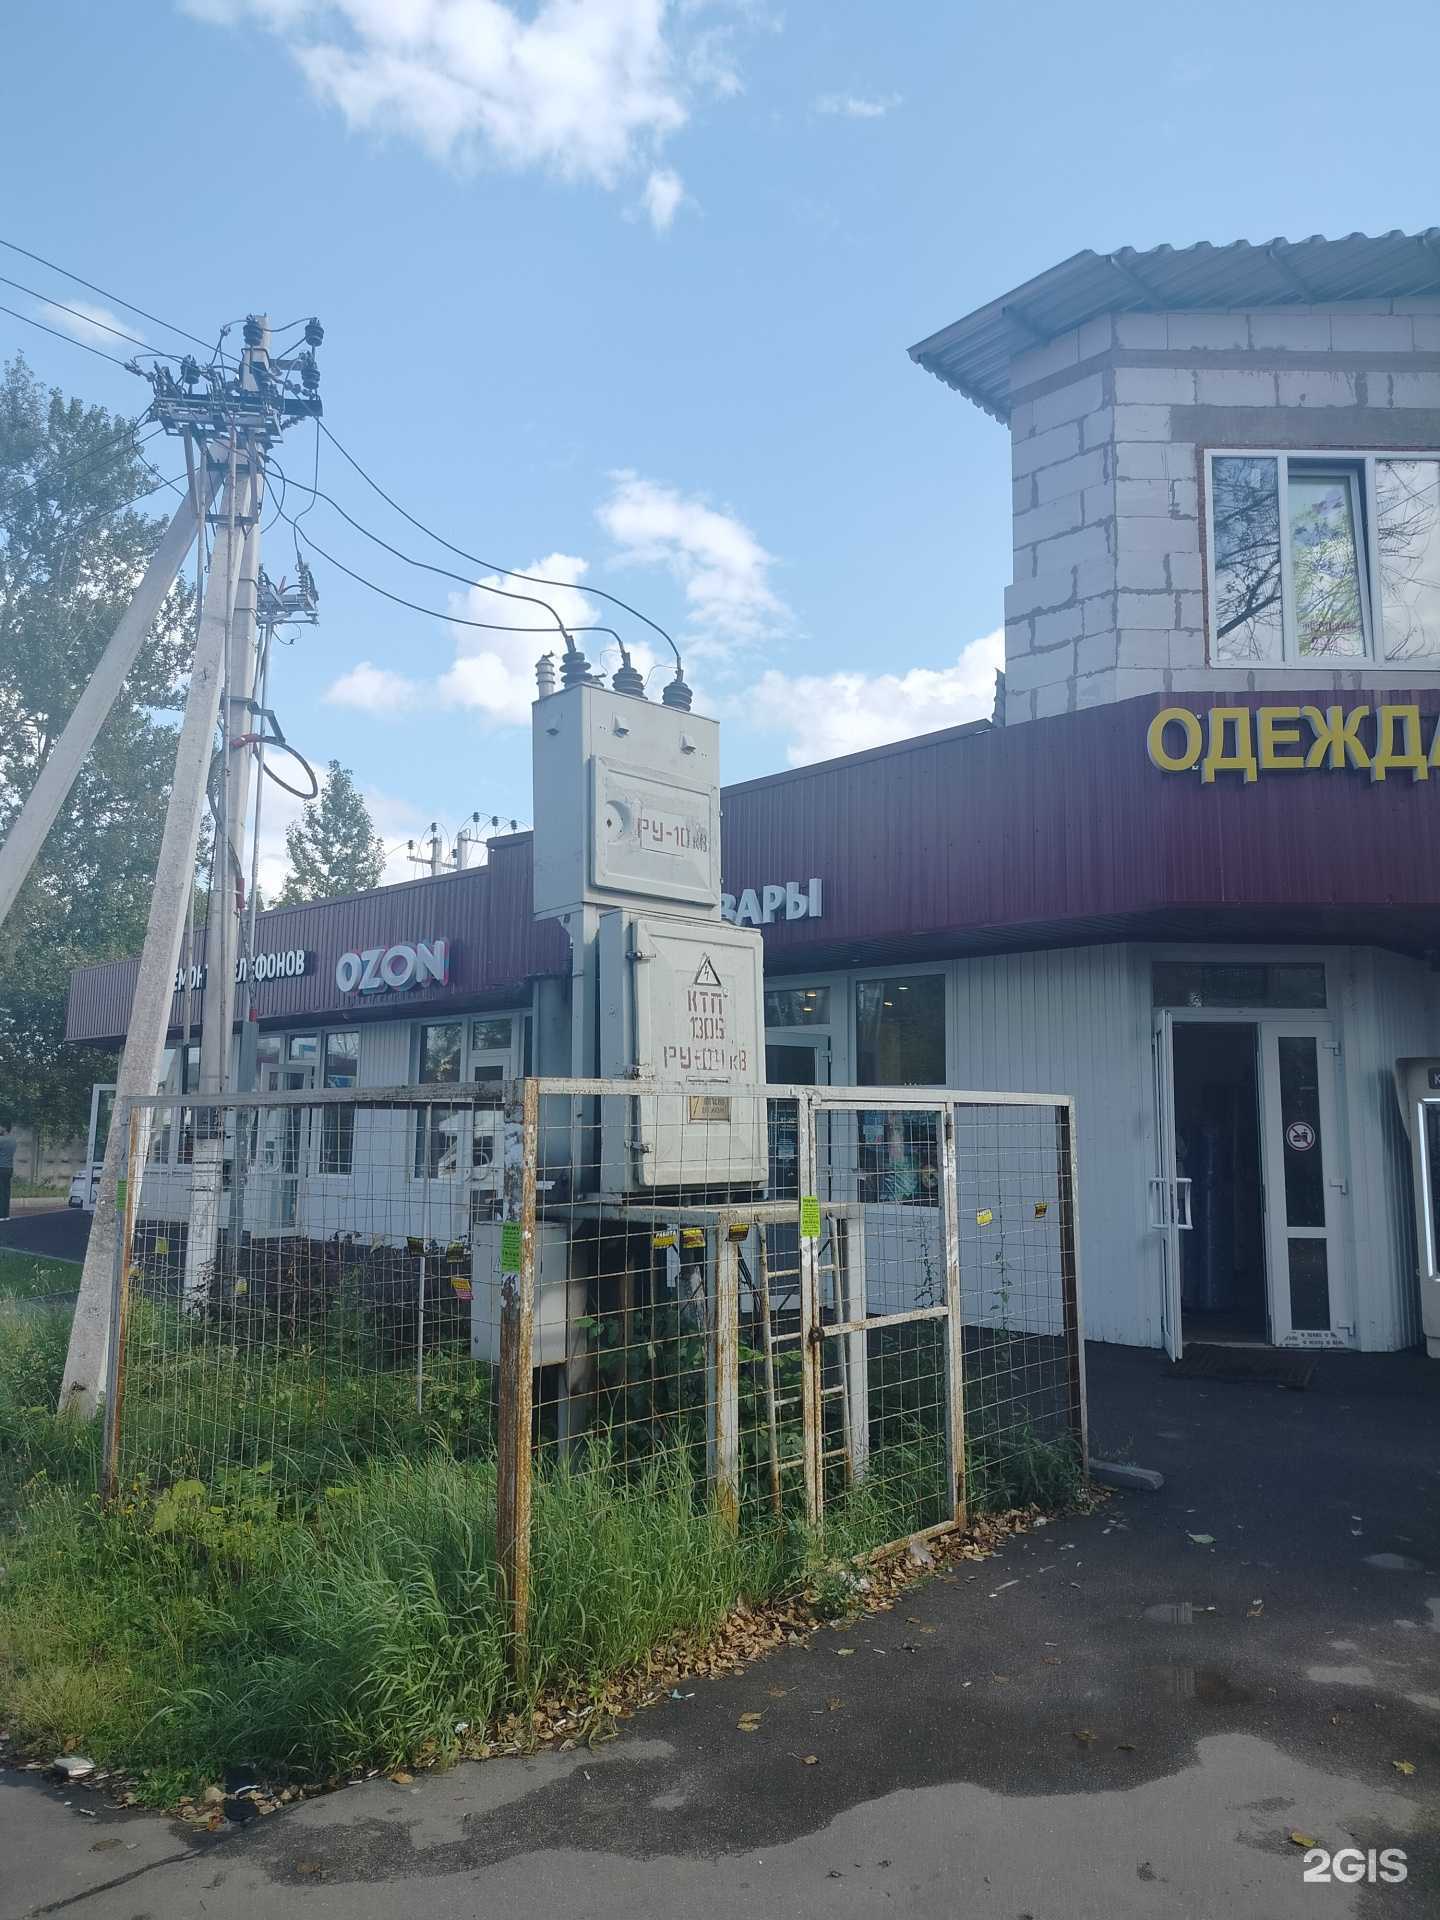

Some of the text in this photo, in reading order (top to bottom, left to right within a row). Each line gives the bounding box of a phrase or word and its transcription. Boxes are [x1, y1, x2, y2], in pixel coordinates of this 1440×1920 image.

[1147, 704, 1440, 785] ОДЕЖД
[721, 877, 823, 927] ВАРЫ
[335, 940, 449, 993] OZON
[687, 990, 723, 1015] КТП
